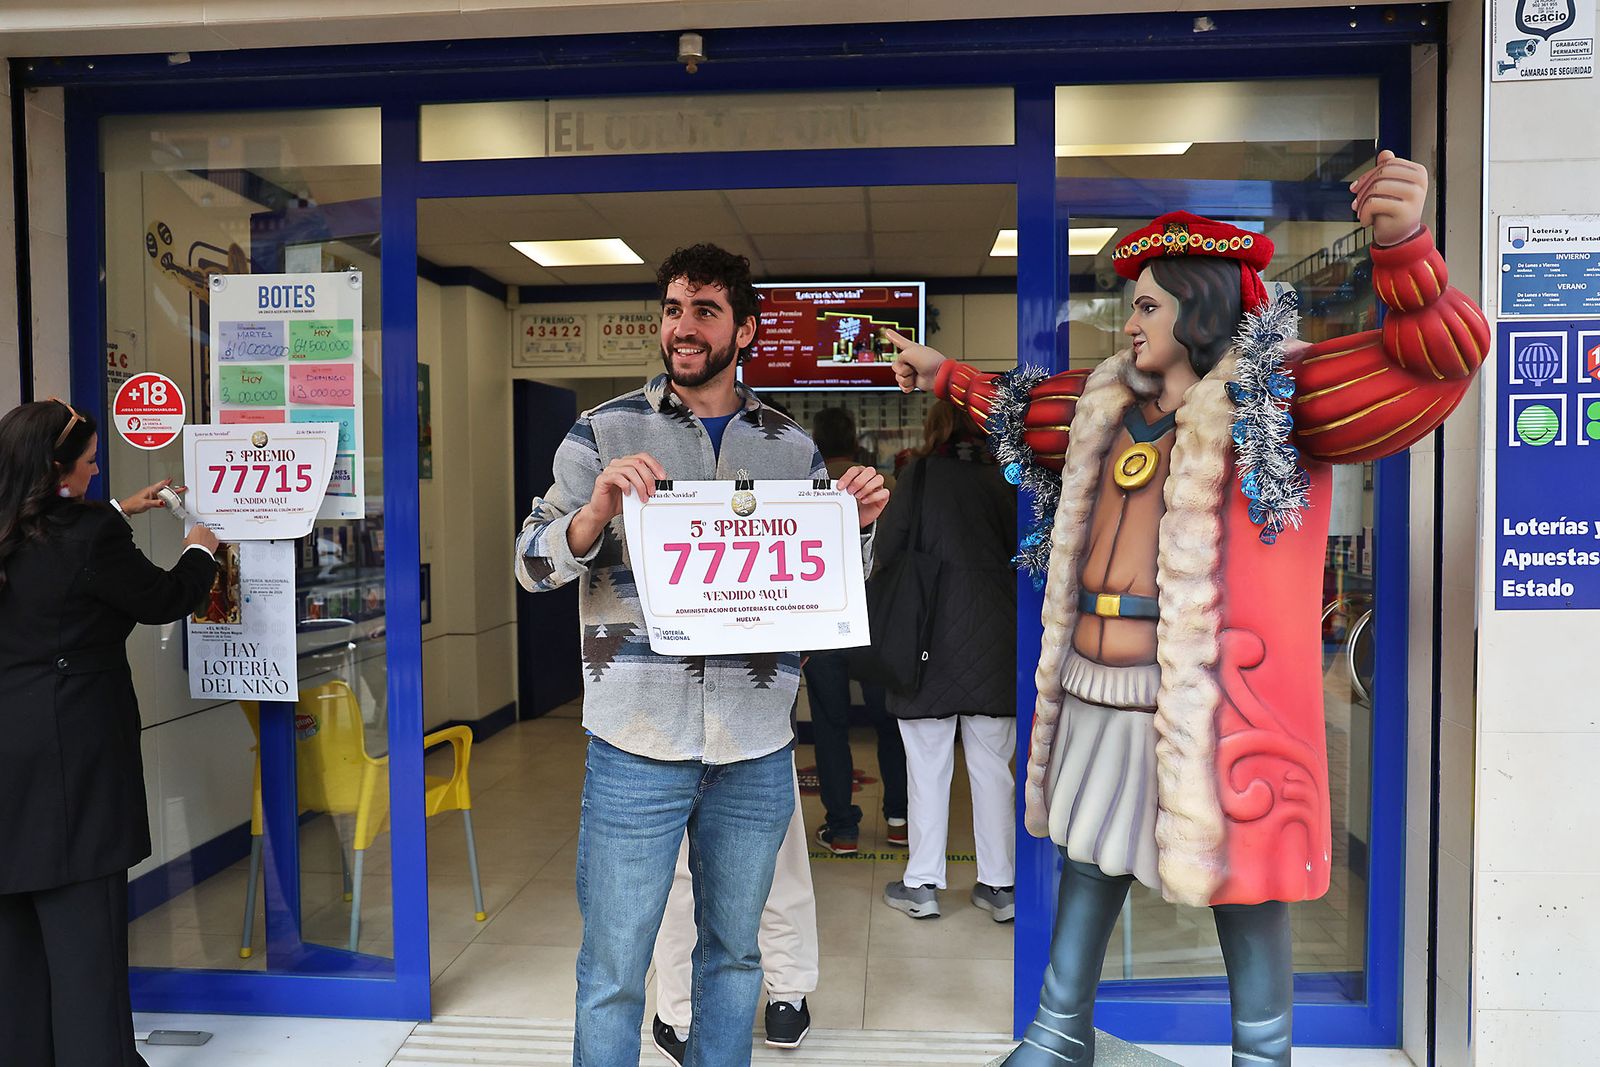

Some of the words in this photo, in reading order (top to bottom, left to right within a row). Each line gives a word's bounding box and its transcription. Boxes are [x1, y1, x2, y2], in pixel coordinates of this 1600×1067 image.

[1524, 11, 1567, 22] acacio
[1520, 68, 1548, 77] CÁMARAS
[1550, 68, 1557, 76] DE
[1558, 66, 1592, 75] SEGURIDAD
[258, 285, 315, 309] BOTES
[237, 331, 273, 339] MARTES
[527, 326, 581, 337] 43422
[603, 324, 657, 335] 08080
[241, 375, 263, 383] HOY
[128, 382, 168, 406] +18
[241, 450, 296, 462] PREMIO
[208, 464, 312, 493] 77715
[714, 518, 797, 537] PREMIO
[1504, 516, 1589, 535] Loterías
[663, 540, 826, 585] 77715
[1502, 548, 1600, 570] Apuestas
[703, 589, 756, 602] VENDIDO
[759, 586, 788, 600] AQUÍ
[1502, 578, 1574, 596] Estado
[224, 643, 259, 657] HAY
[204, 658, 280, 676] LOTERÍA
[201, 678, 237, 693] DEL
[242, 677, 289, 694] NIÑO
